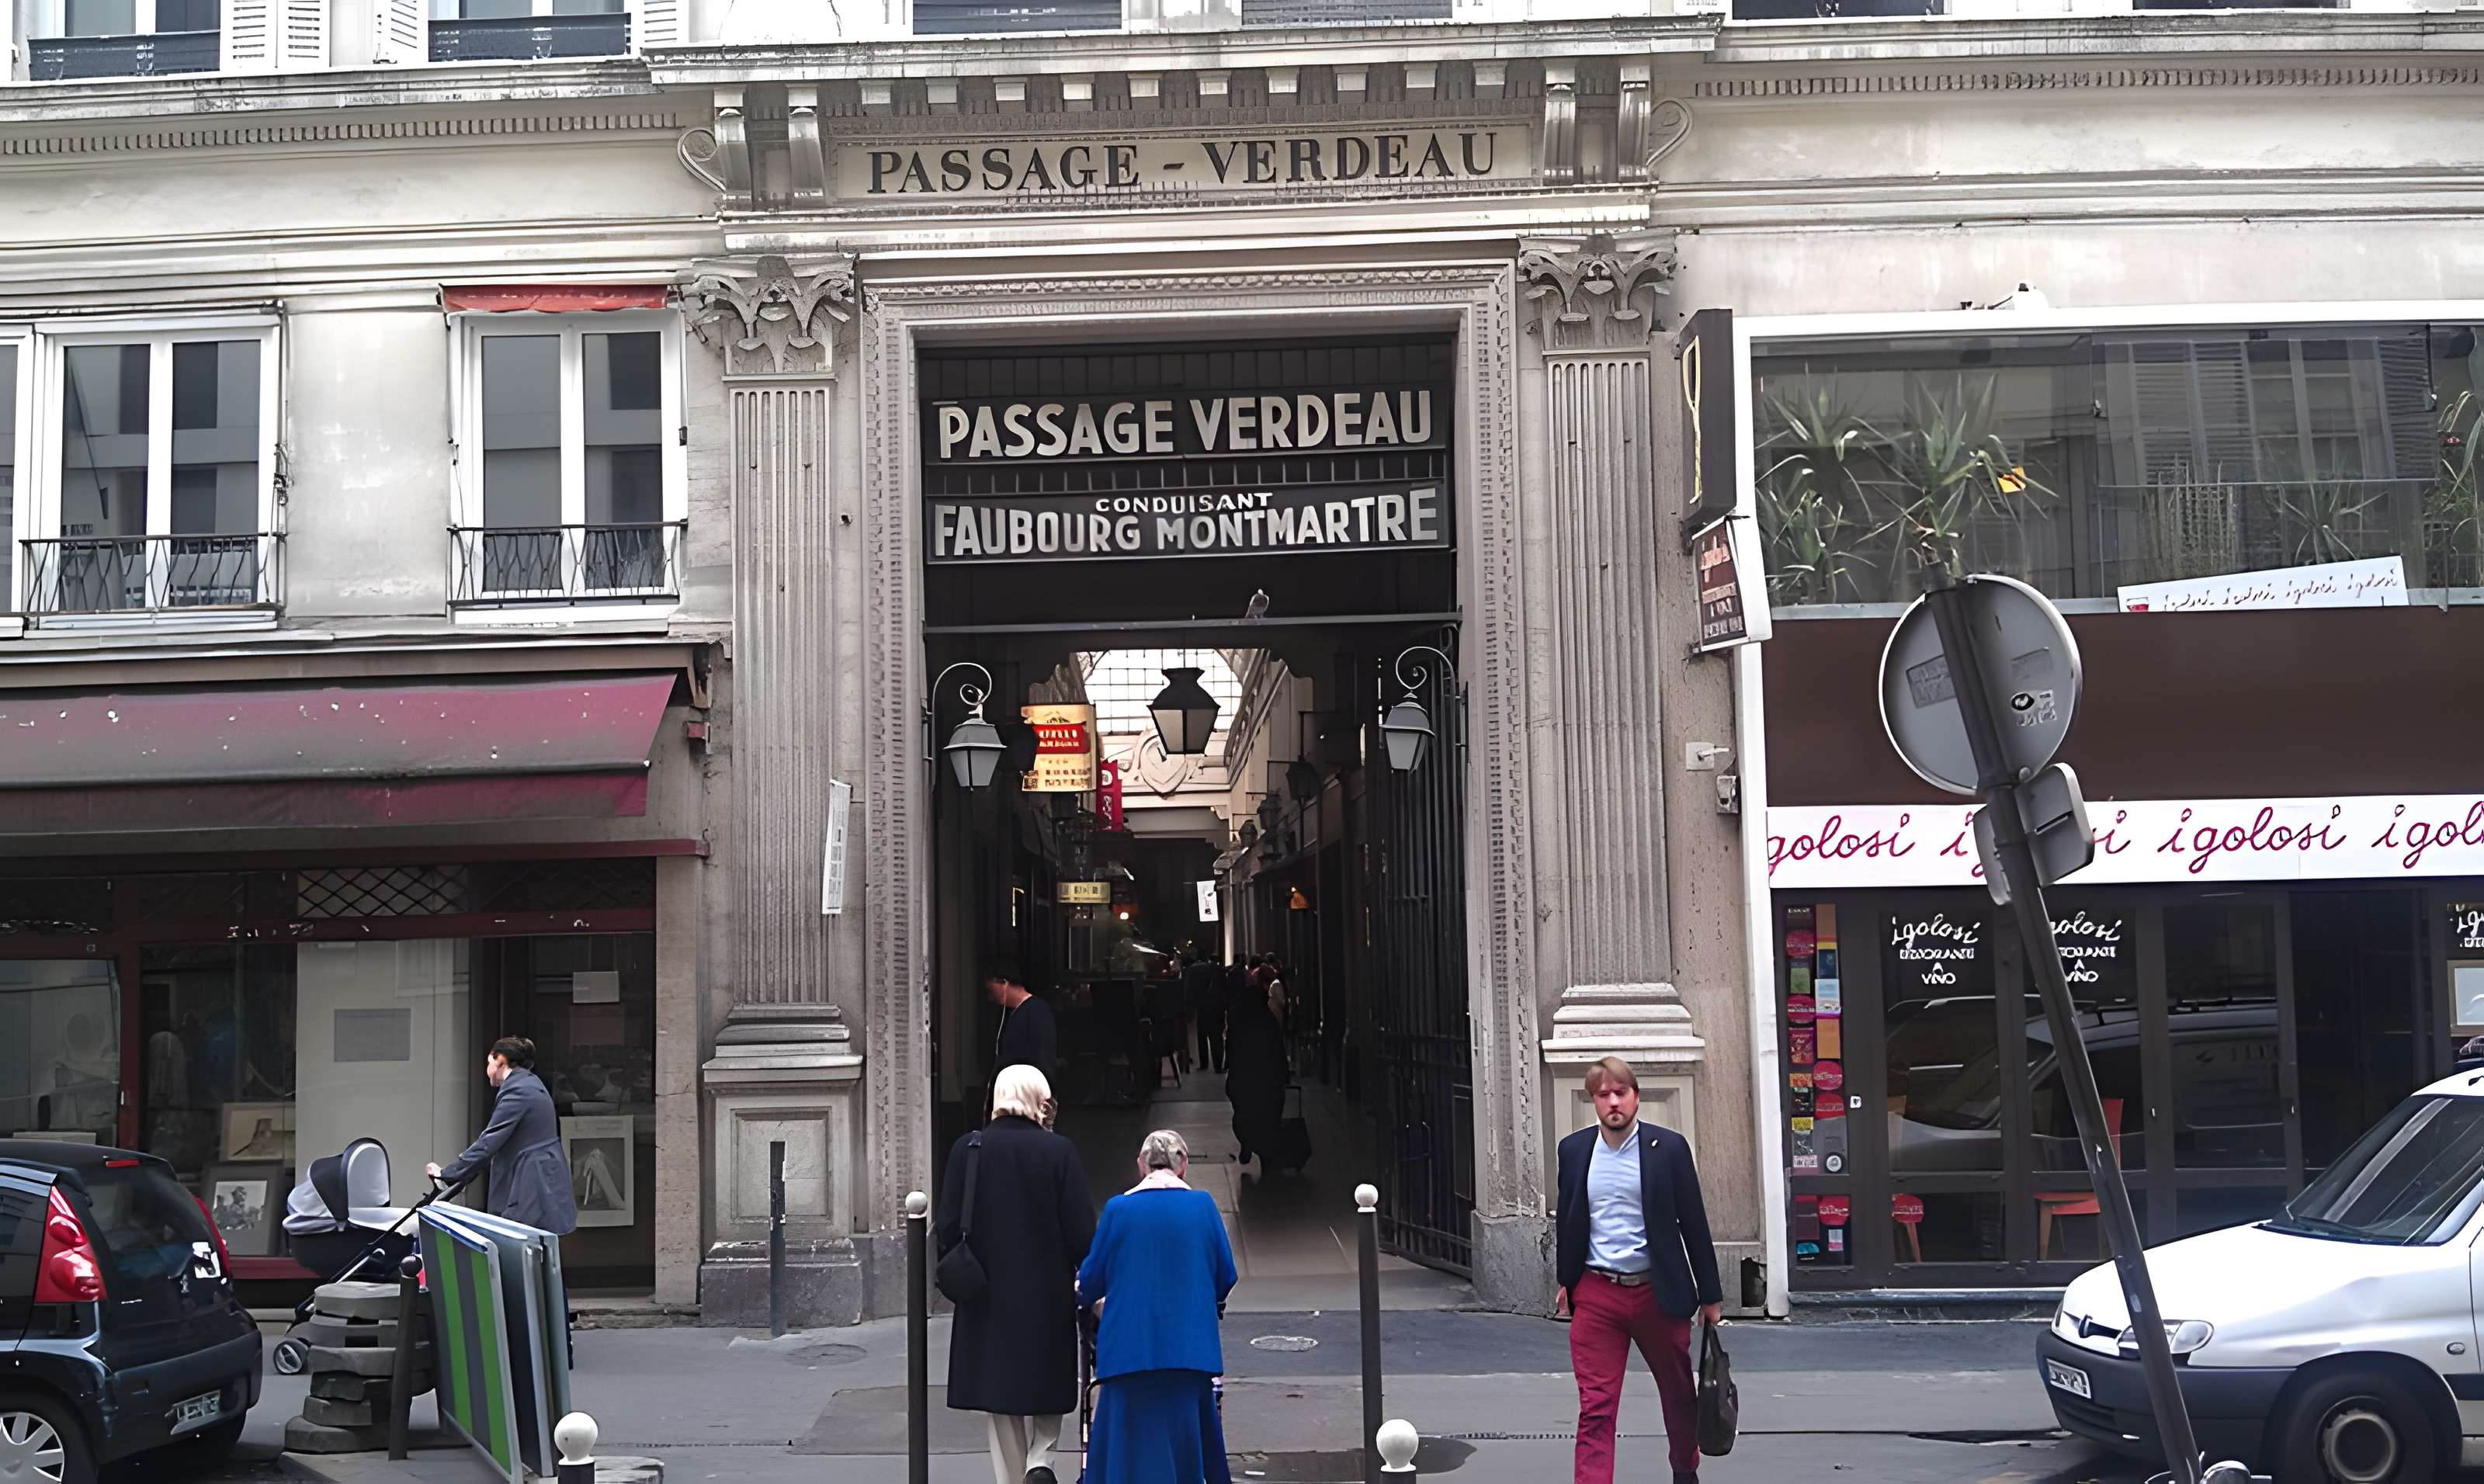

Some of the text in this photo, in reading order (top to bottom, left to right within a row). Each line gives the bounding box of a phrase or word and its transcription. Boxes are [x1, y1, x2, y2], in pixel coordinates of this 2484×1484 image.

[866, 144, 1140, 194] PASSAGE
[1200, 133, 1497, 184] VERDEAU
[939, 390, 1431, 459] PASSAGE VERDEAU
[935, 487, 1438, 556] FAUBOURG MONTMARTRE
[1095, 492, 1273, 514] CONDUISANT
[2371, 801, 2484, 869] igol
